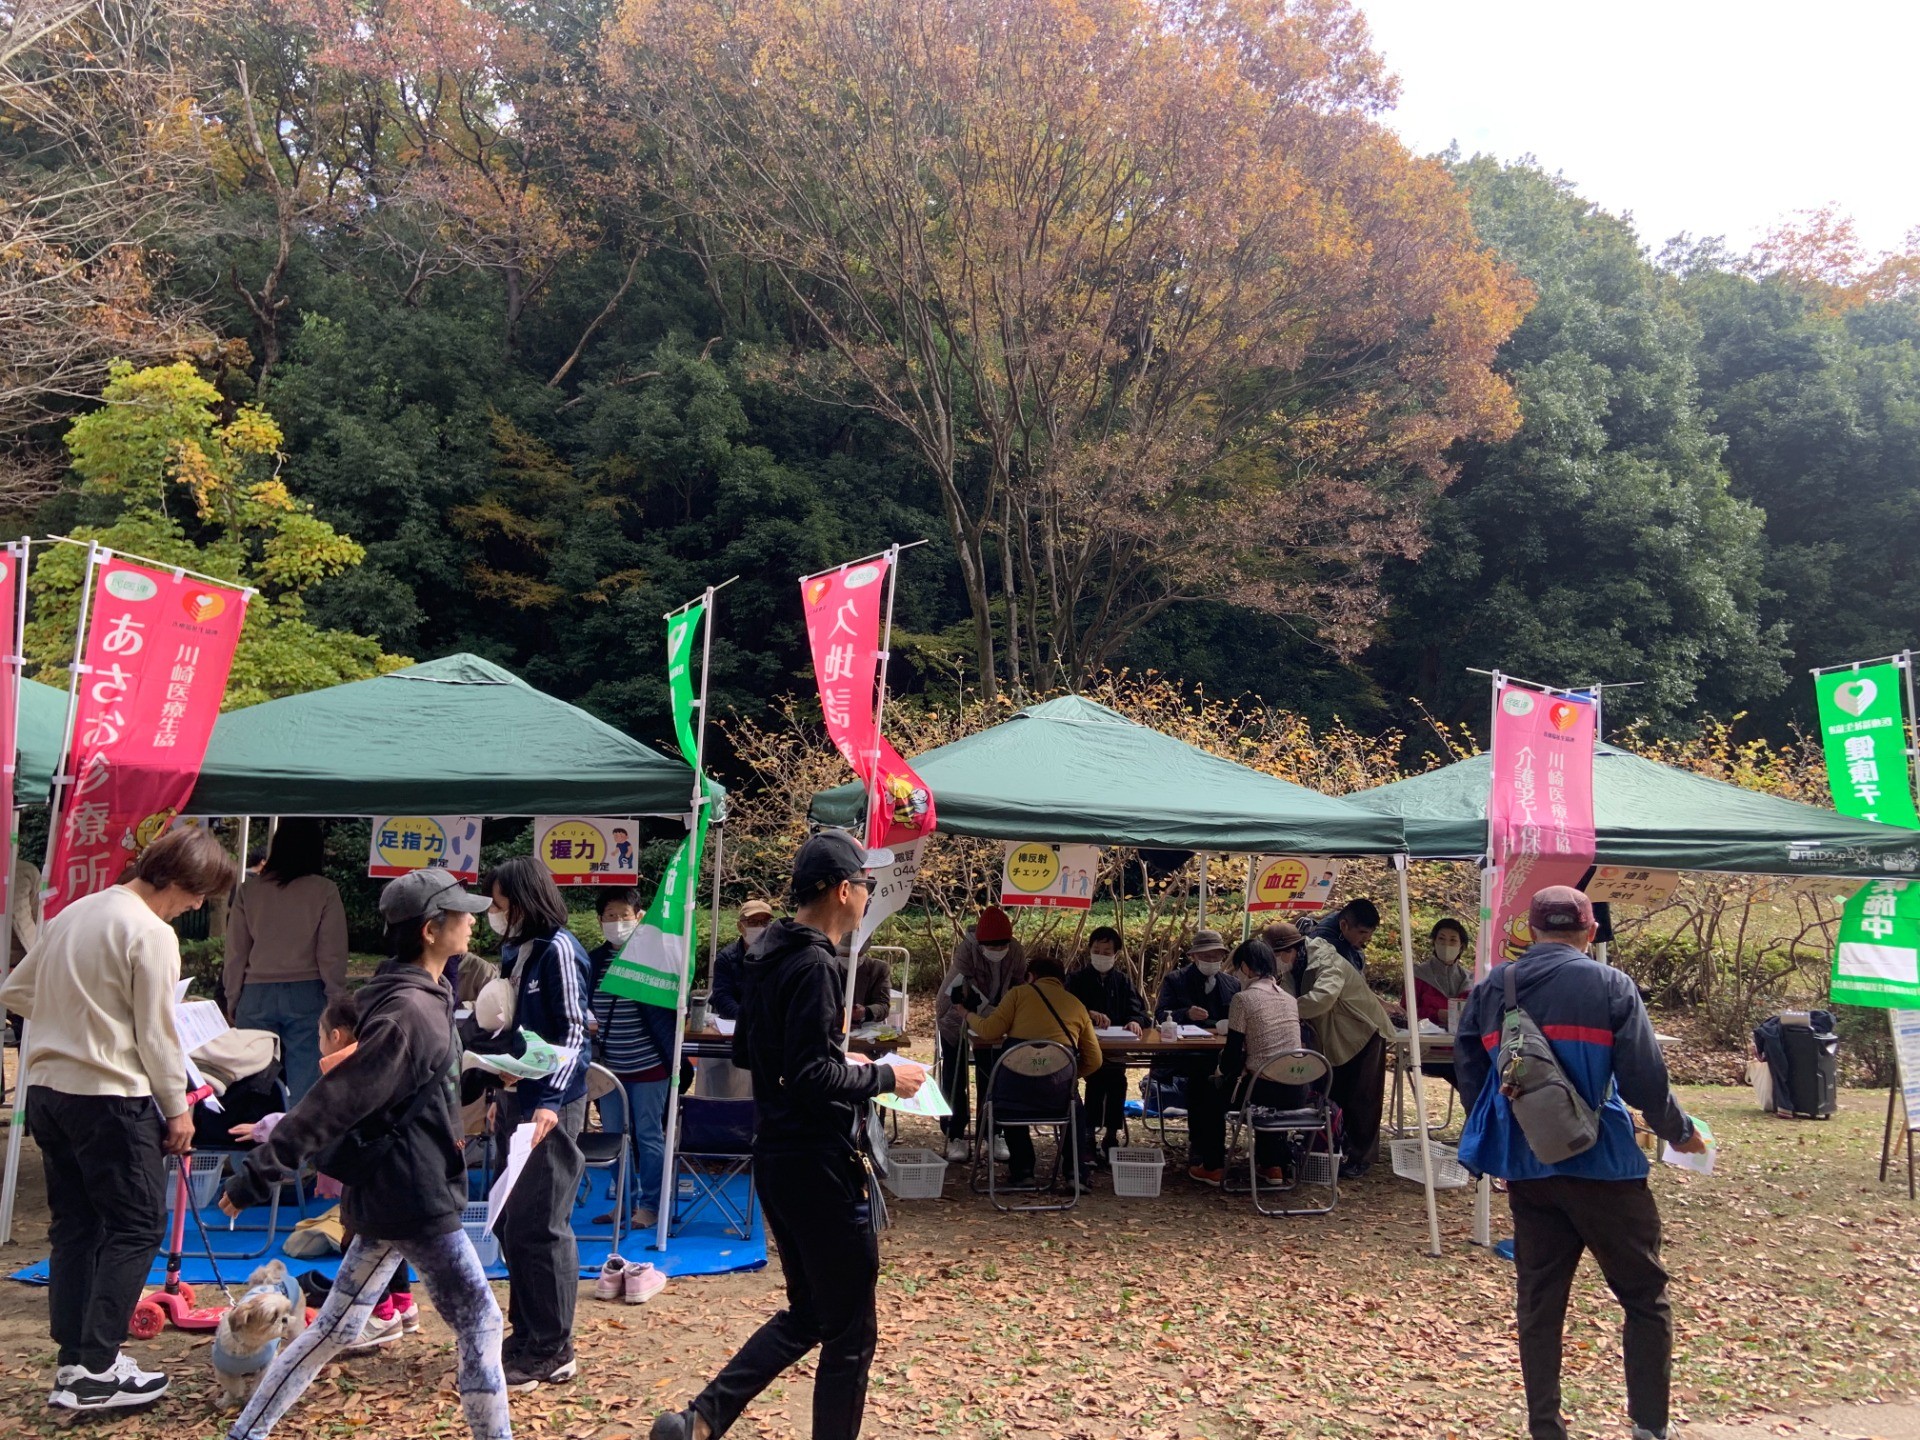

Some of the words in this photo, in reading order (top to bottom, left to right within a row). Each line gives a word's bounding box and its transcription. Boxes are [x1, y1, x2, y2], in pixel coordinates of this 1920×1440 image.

[152, 643, 200, 748] 川崎医療生協
[65, 613, 146, 901] あさお診療所
[1547, 751, 1572, 855] 川崎医療生協
[379, 830, 444, 853] 足指力
[549, 838, 596, 860] 握力
[427, 857, 448, 868] 測定
[895, 848, 915, 863] 電話
[1018, 852, 1049, 864] 棒反射
[588, 861, 610, 872] 測定
[1012, 867, 1051, 883] チェック
[1263, 872, 1302, 890] 血圧
[1623, 870, 1651, 881] 健康
[1593, 881, 1666, 892] クイズラリー
[1607, 891, 1635, 900] 受付
